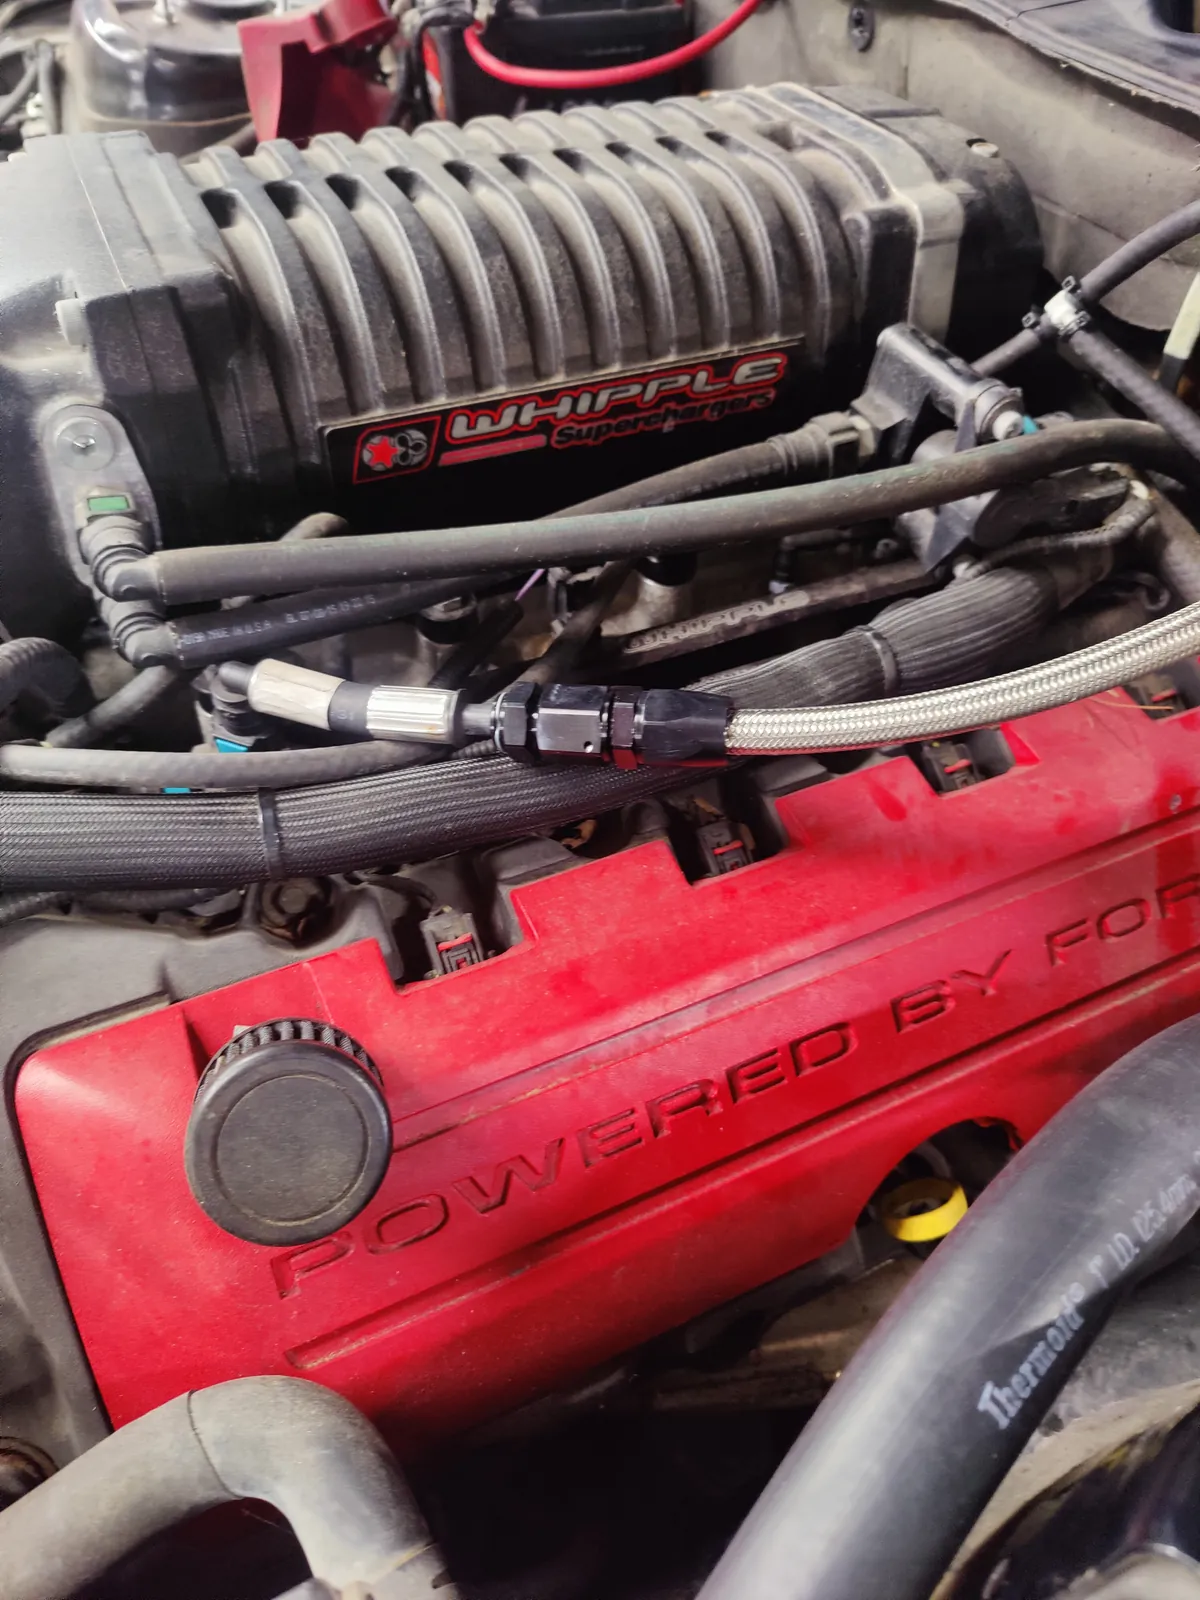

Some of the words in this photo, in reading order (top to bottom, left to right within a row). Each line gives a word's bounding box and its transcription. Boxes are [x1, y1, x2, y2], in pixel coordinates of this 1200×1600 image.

[450, 354, 786, 442] WHIPPLE
[552, 389, 775, 447] Superchargers
[269, 1020, 860, 1300] POWERED
[890, 949, 1013, 1033] BY
